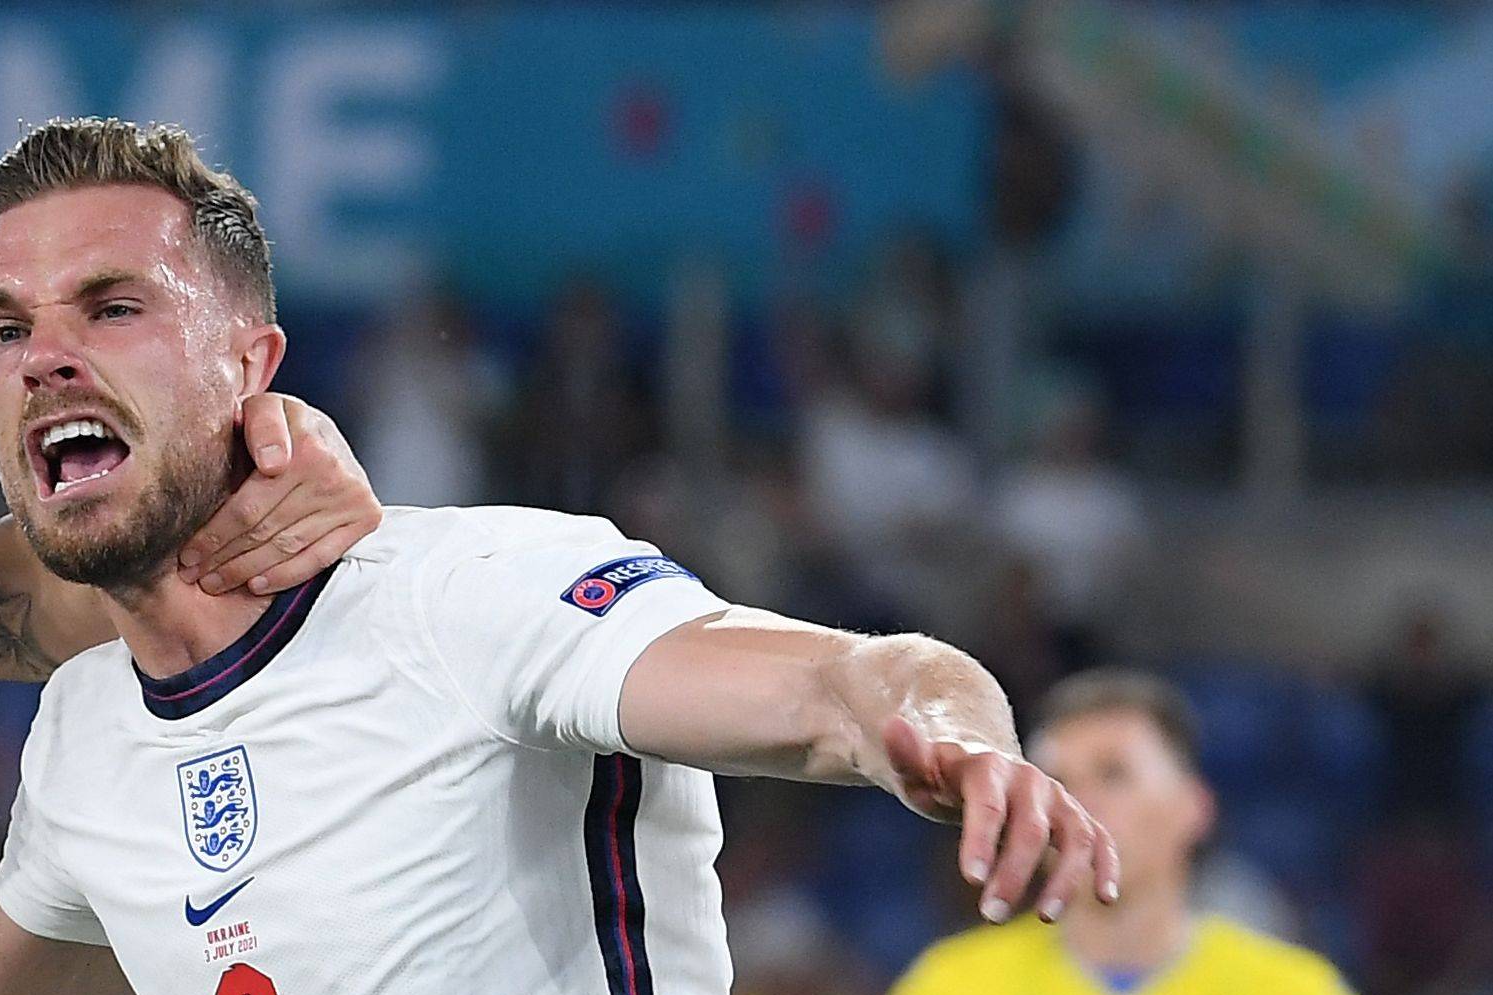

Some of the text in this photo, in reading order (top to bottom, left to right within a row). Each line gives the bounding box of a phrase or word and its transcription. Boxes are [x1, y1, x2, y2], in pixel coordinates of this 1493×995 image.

[206, 921, 250, 944] UKRAINE
[213, 942, 234, 960] JULY
[238, 935, 258, 953] 2021
